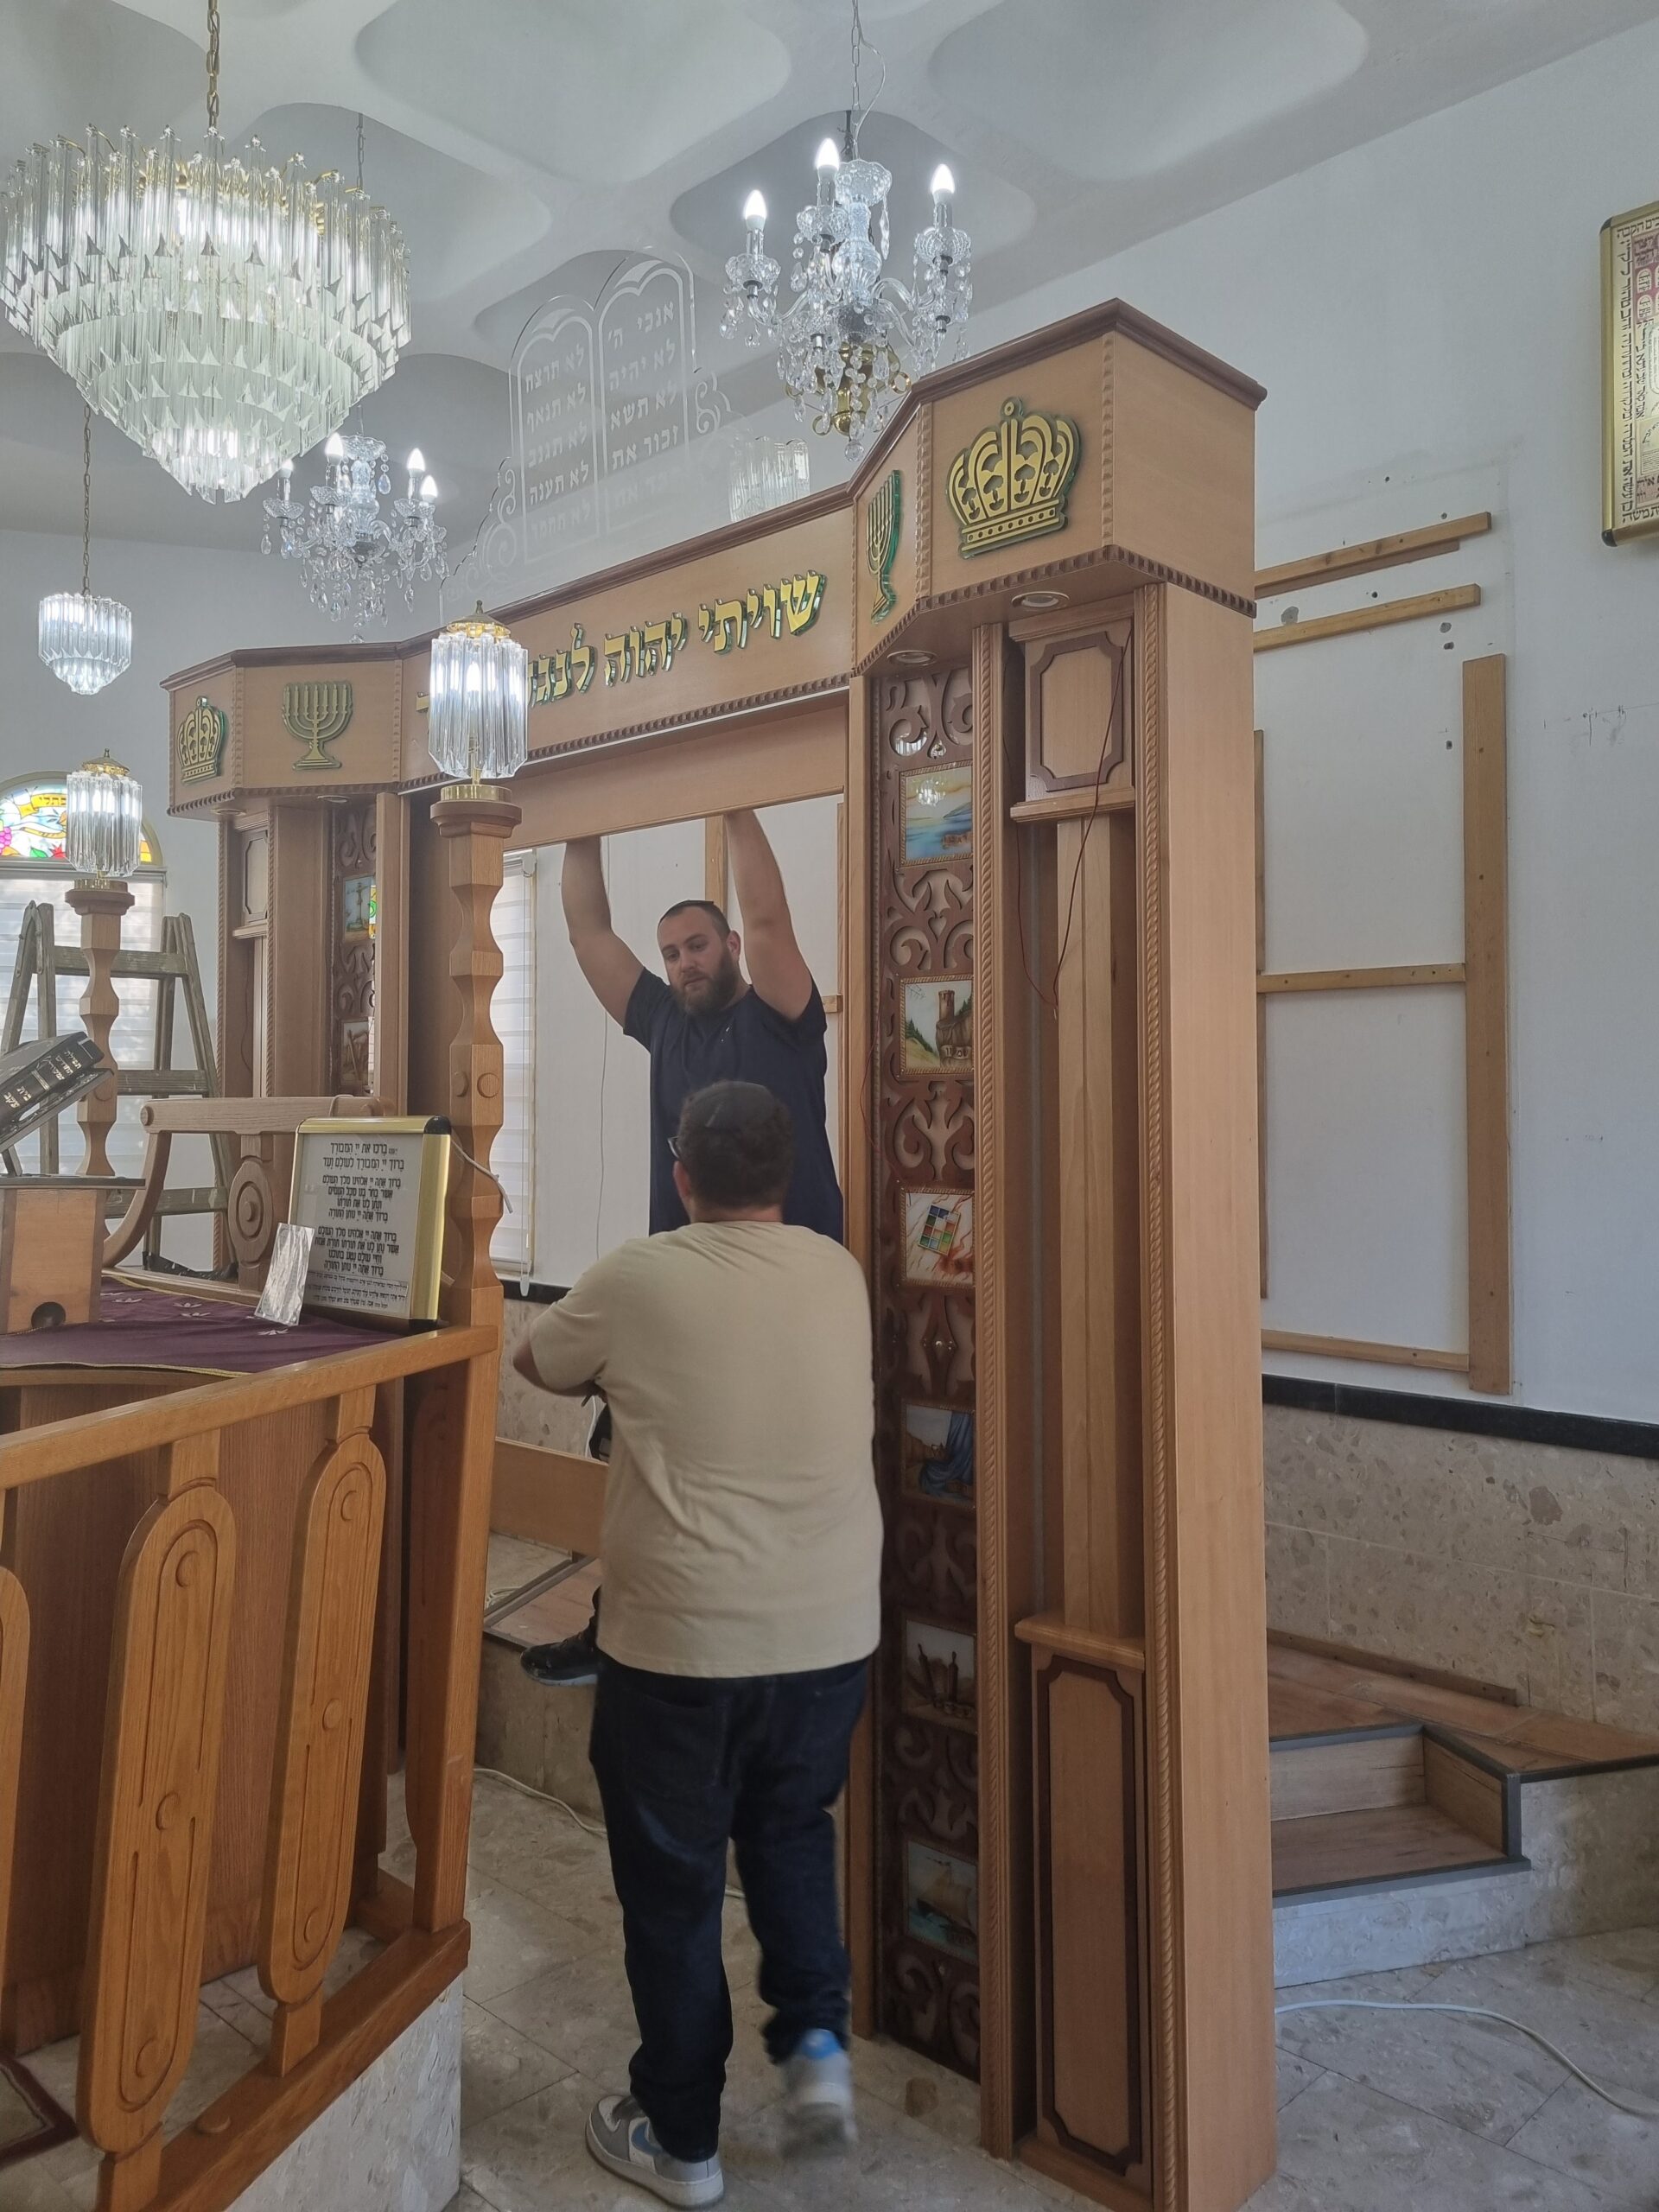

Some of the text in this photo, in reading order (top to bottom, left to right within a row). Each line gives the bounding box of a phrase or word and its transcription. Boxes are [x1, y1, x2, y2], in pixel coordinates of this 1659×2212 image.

[637, 301, 673, 333] אנכי
[525, 343, 584, 393] לא תרצח
[609, 339, 676, 391] לא יהיה
[527, 382, 586, 434] לא תנאף
[610, 380, 677, 431] לא תשא
[528, 421, 588, 468] לא תגנב
[612, 424, 678, 470] זכור את
[530, 461, 588, 505] לא תענה
[571, 499, 590, 525] לא
[699, 569, 828, 654] שויתי
[604, 611, 688, 688] יהוה
